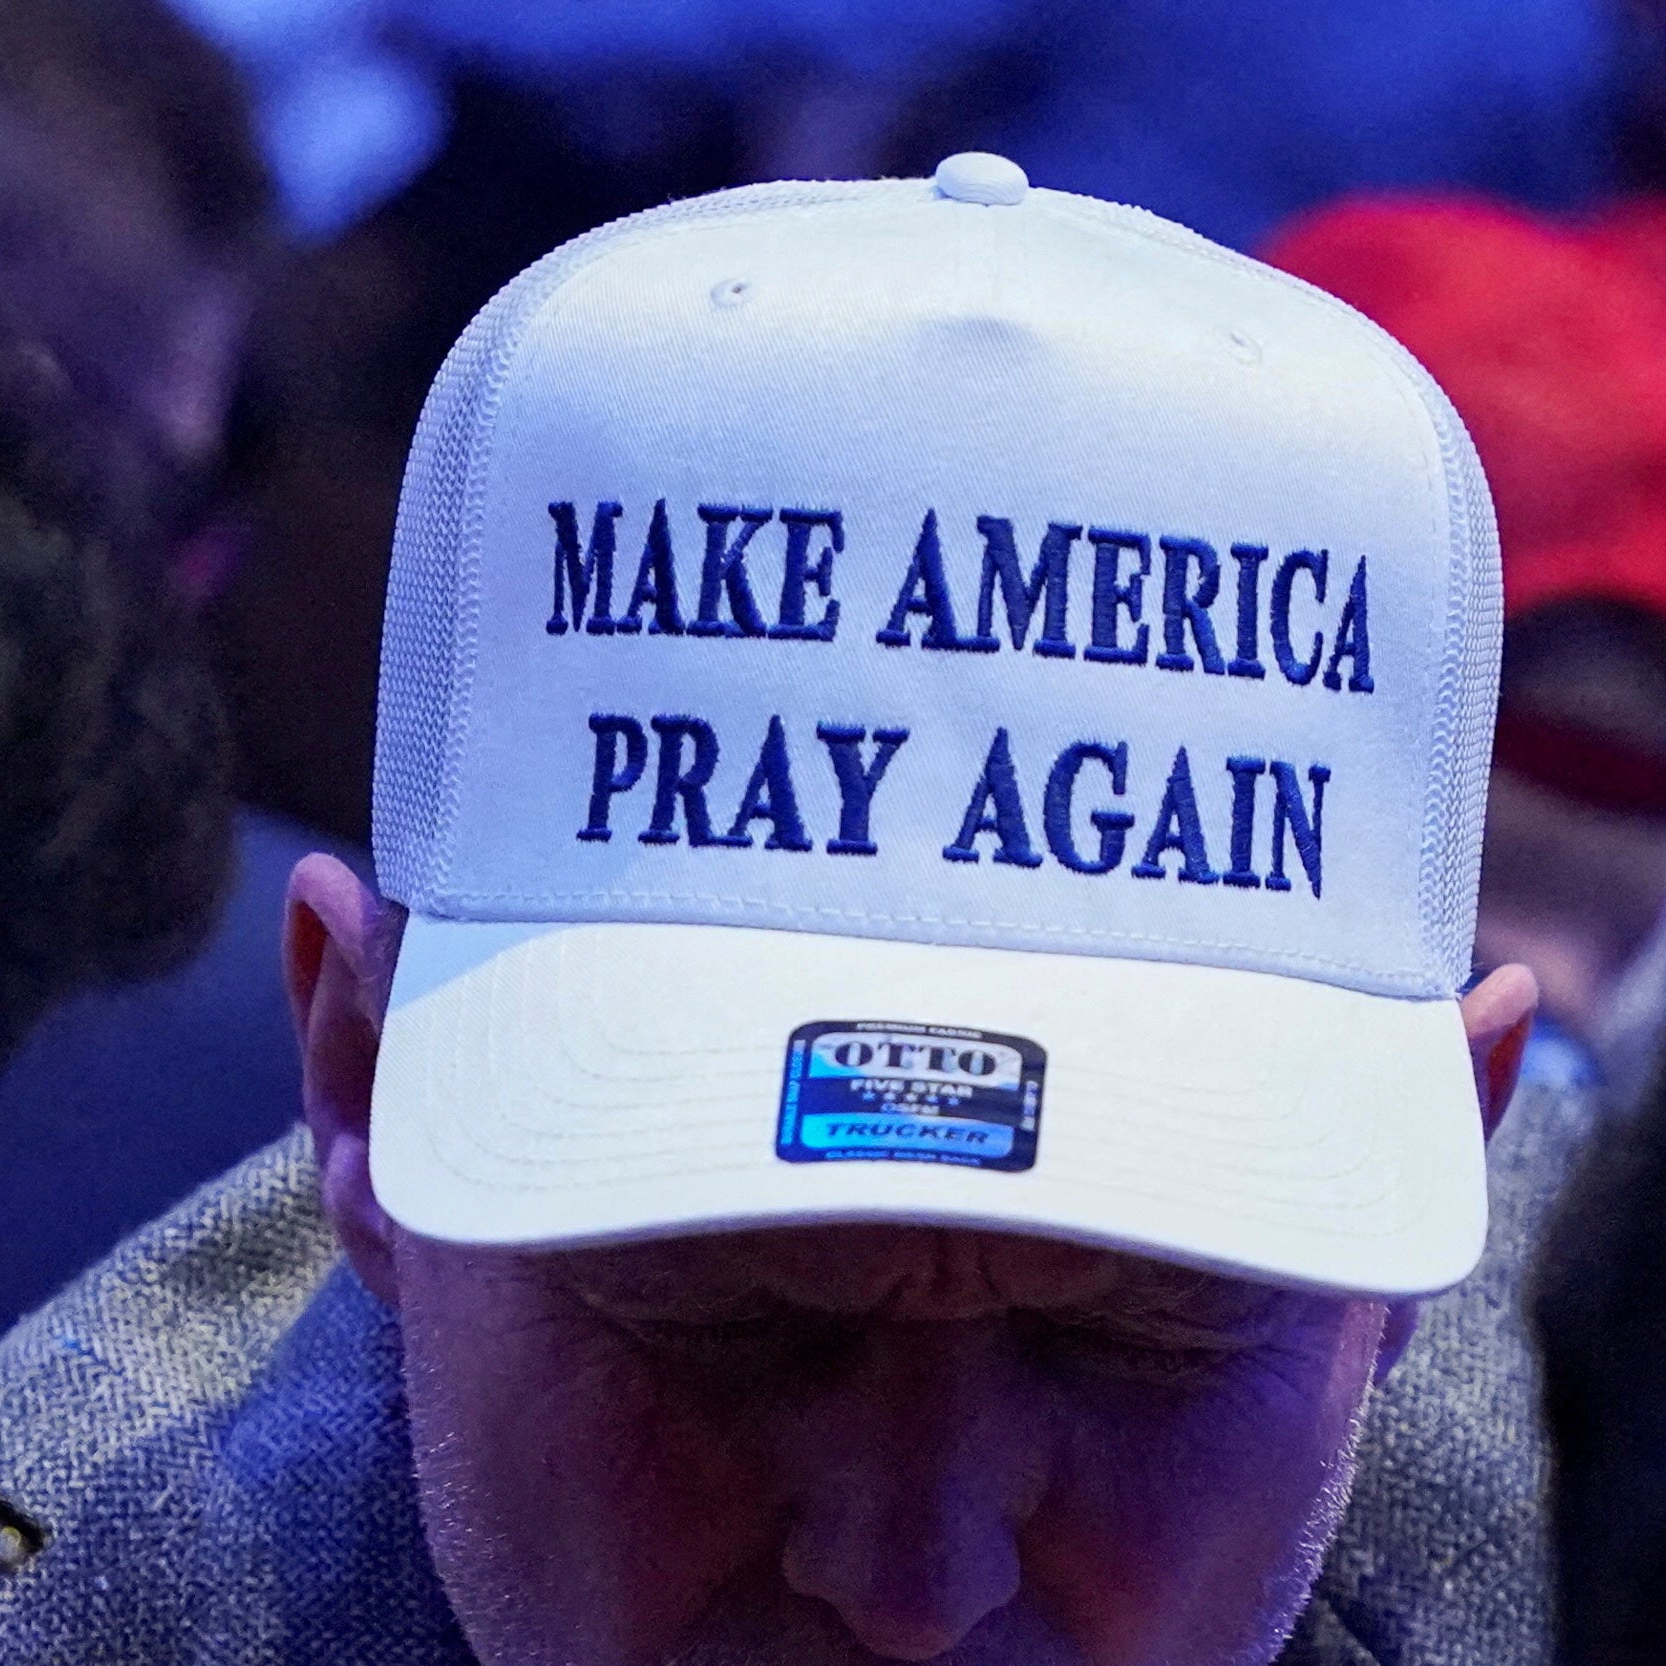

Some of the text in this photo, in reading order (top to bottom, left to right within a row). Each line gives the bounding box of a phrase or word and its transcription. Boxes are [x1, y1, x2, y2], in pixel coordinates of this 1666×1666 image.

[545, 497, 1375, 695] MAKE AMERICA
[575, 712, 1331, 900] PRAY AGAIN
[835, 1041, 996, 1076] OTTO
[850, 1079, 973, 1098] FIVE STAR
[827, 1122, 989, 1144] TRUCKER
